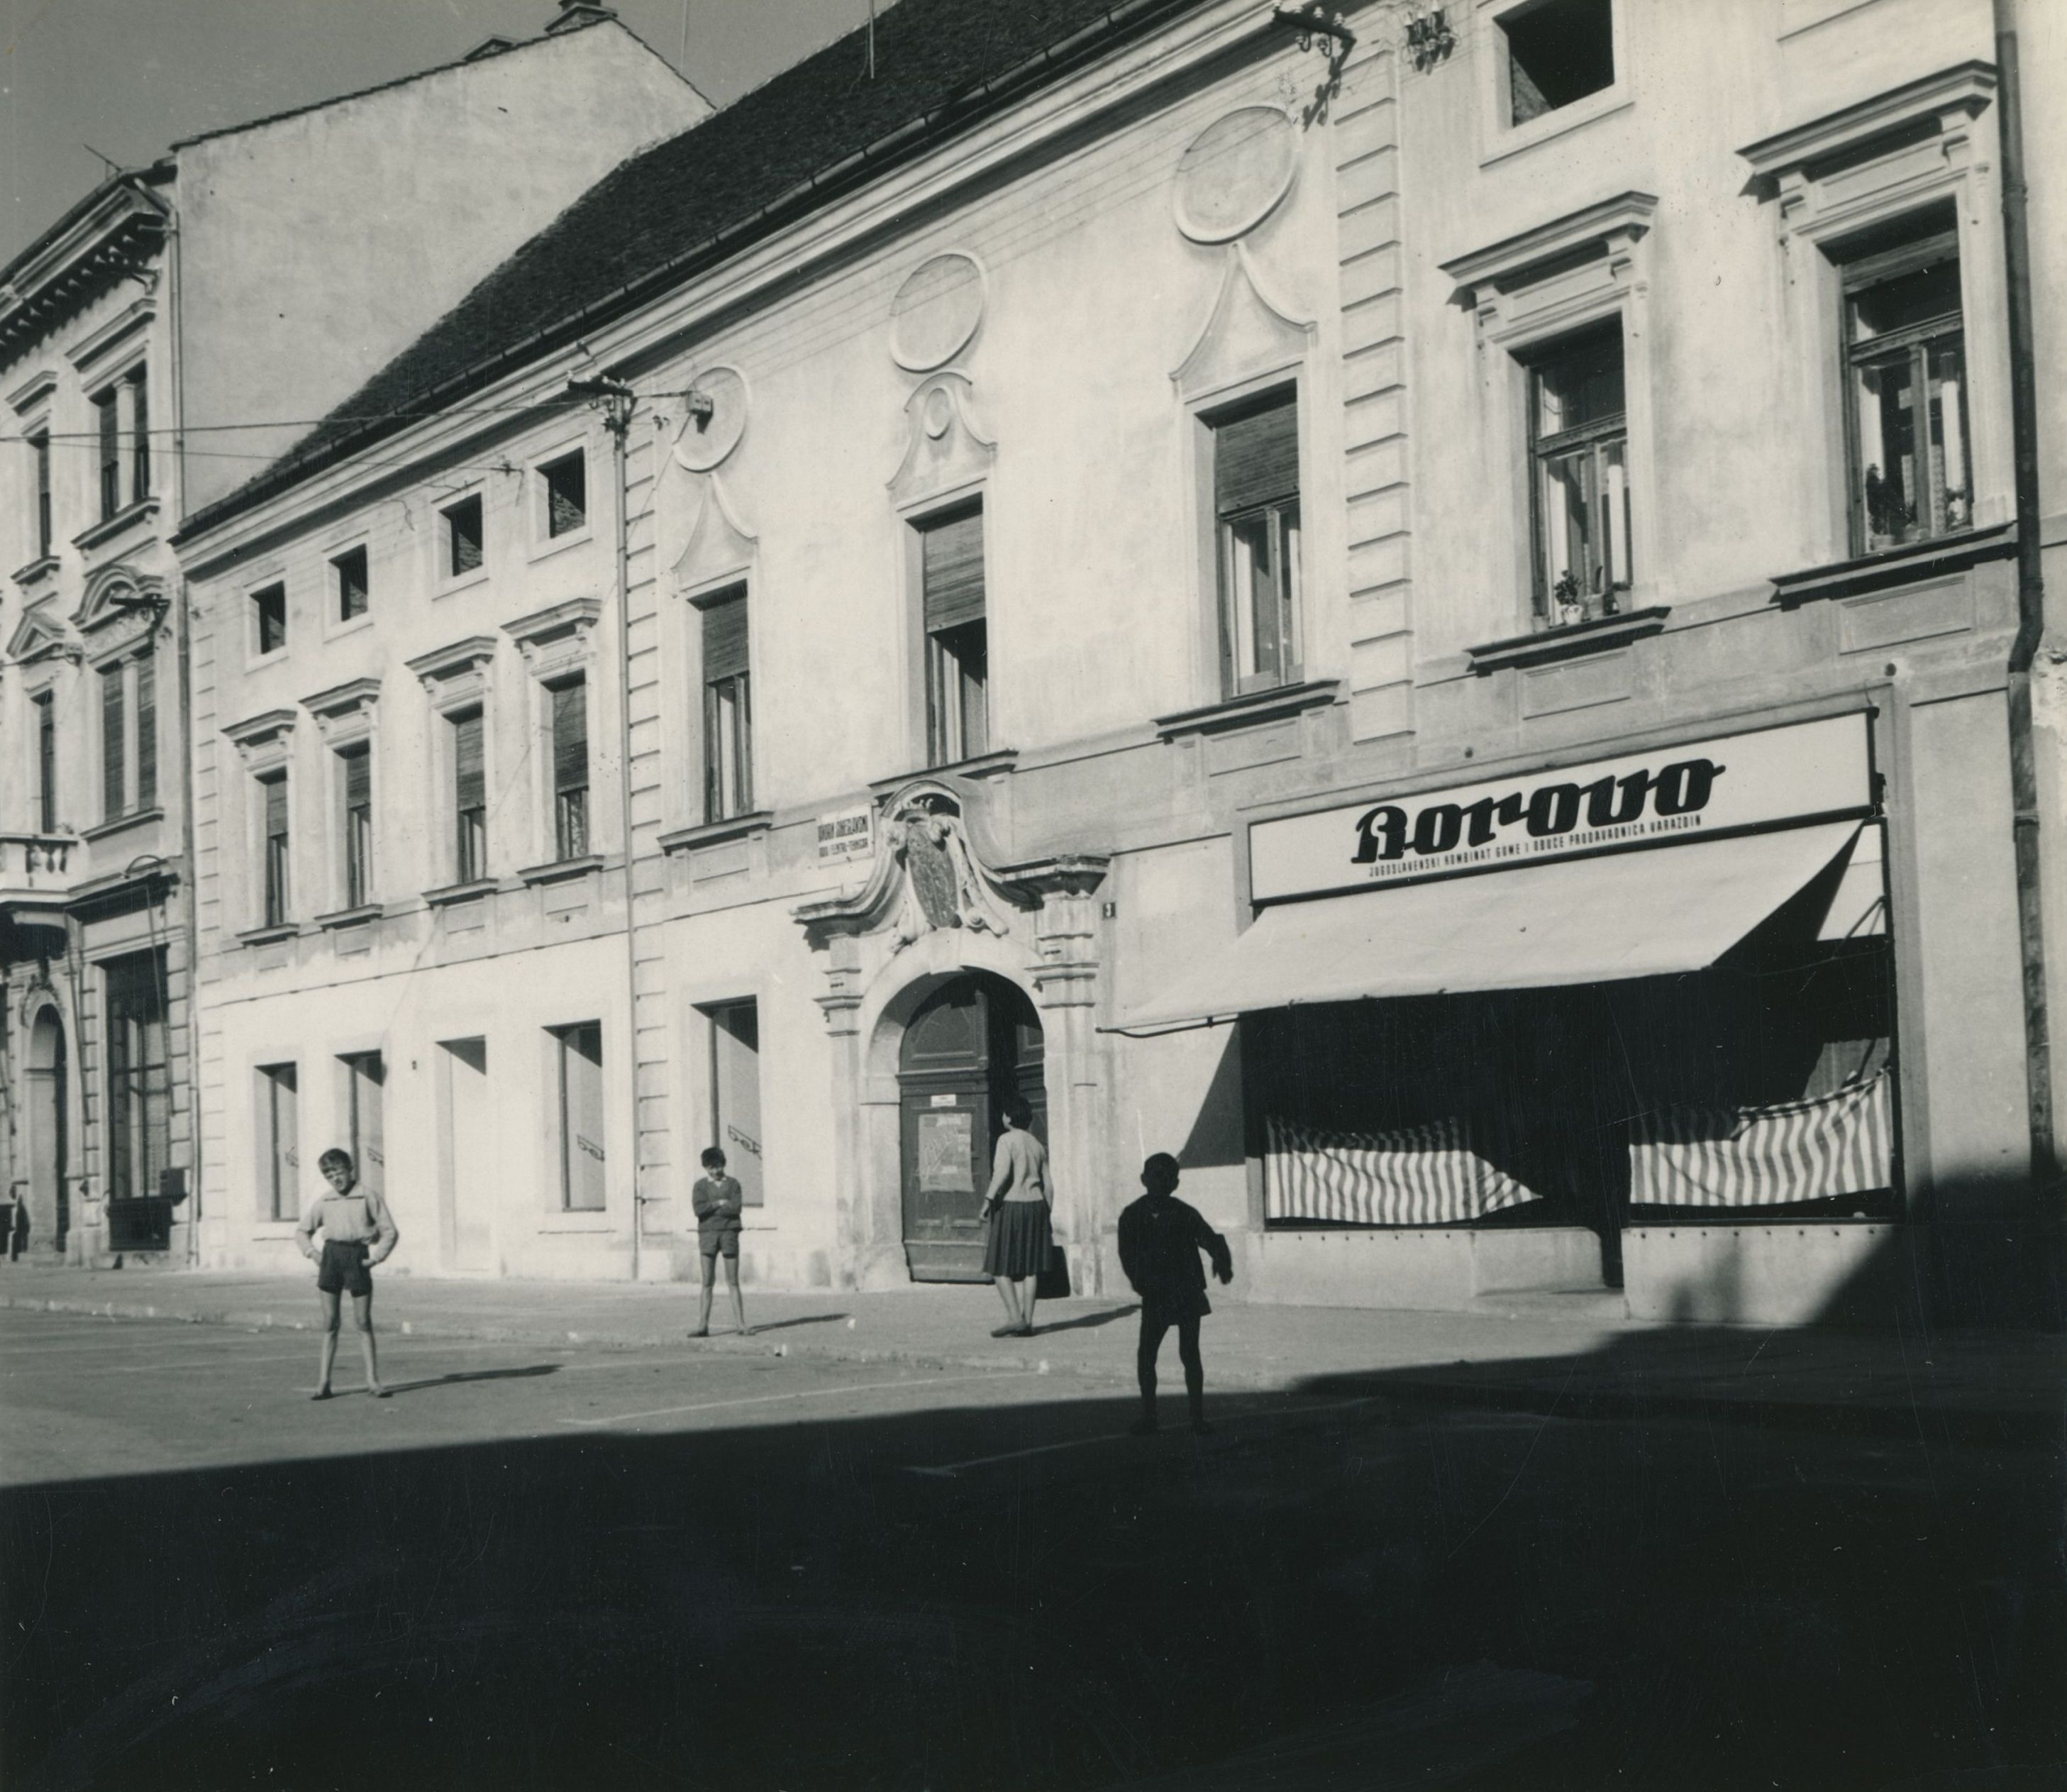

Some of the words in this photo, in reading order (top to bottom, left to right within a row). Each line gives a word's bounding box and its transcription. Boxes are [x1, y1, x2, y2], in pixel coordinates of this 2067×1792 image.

[1351, 758, 1727, 863] Borovo
[1369, 857, 1440, 877] JUGOSLAVENSKI
[1444, 848, 1491, 865] KOMBINAT
[1495, 842, 1521, 857] GUME
[1569, 824, 1645, 846] PRODAVAONICA
